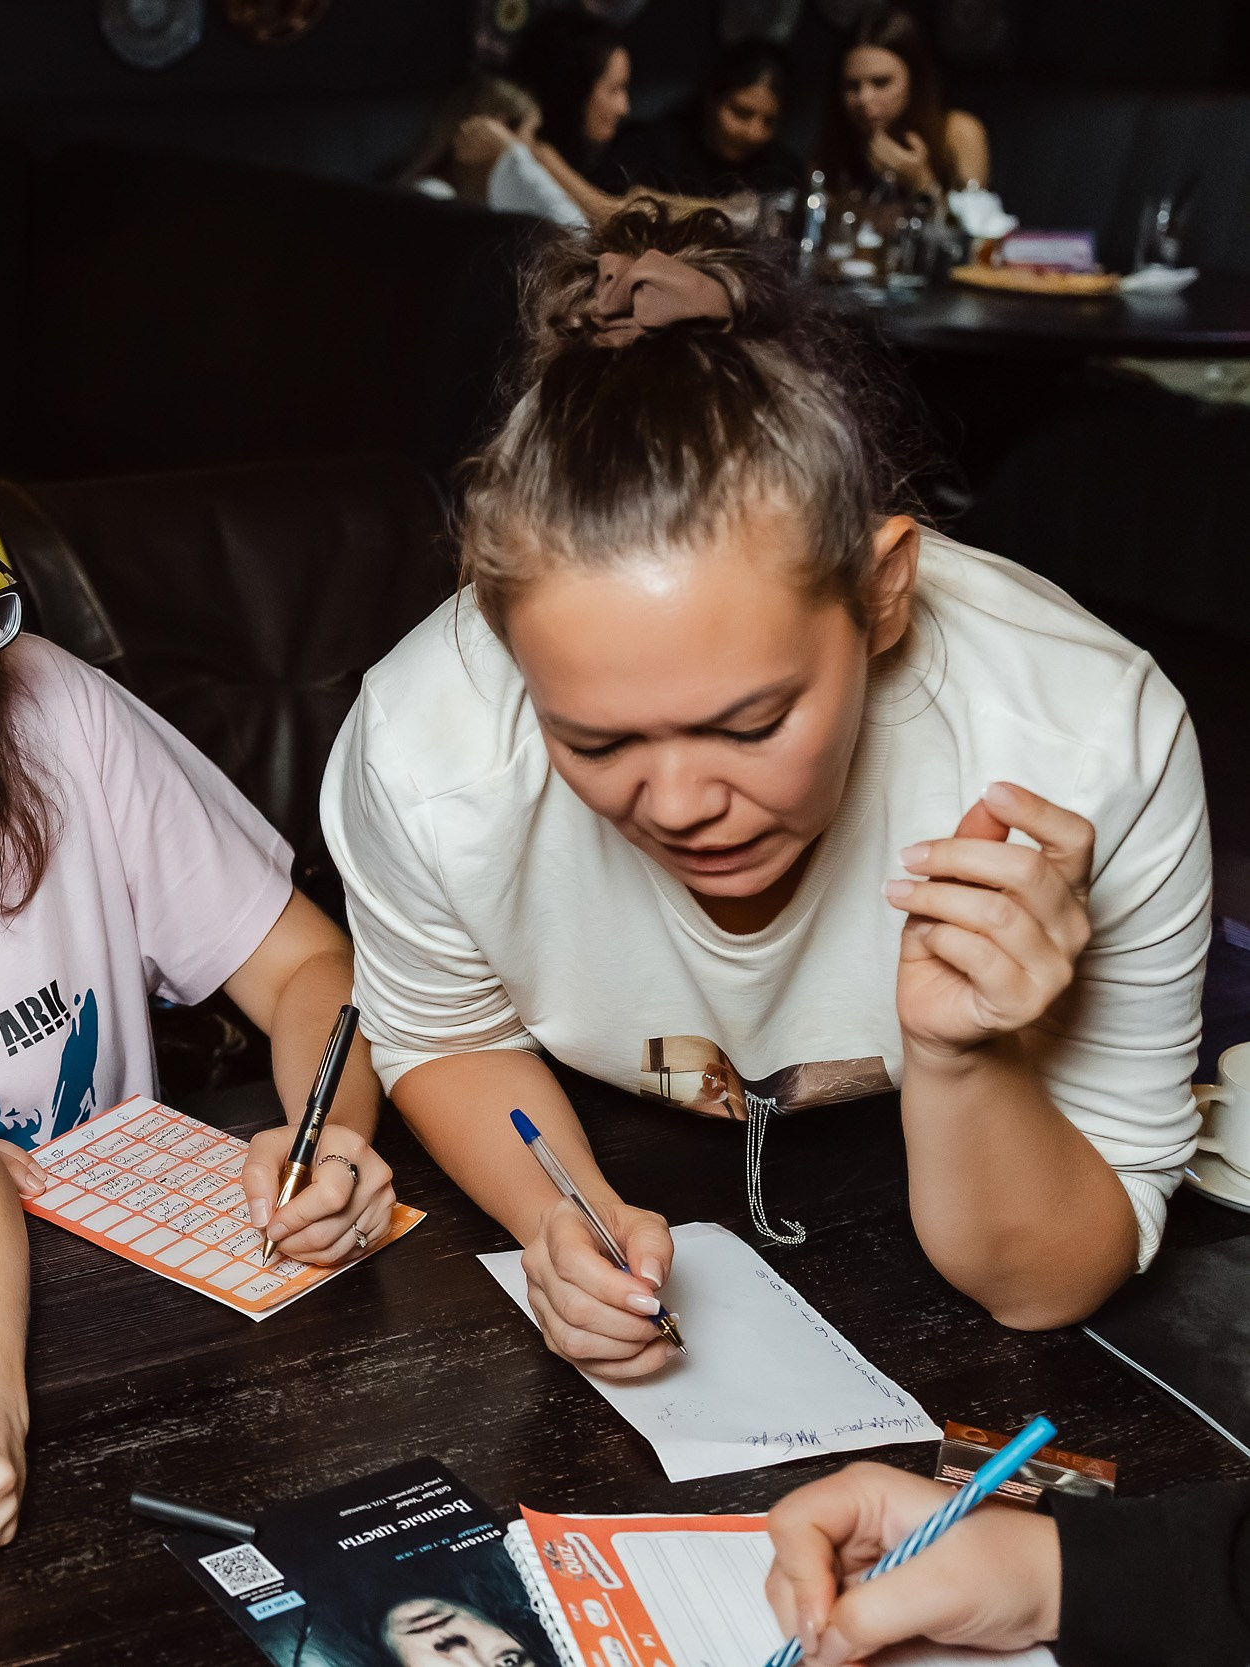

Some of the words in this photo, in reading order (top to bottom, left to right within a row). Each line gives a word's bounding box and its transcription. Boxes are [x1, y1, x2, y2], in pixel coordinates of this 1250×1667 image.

[1041, 1448, 1100, 1471] EREA
[421, 1485, 452, 1500] Grill-bar
[397, 1498, 474, 1530] Вечные
[338, 1521, 398, 1551] цветы
[557, 1544, 583, 1575] QUIZ
